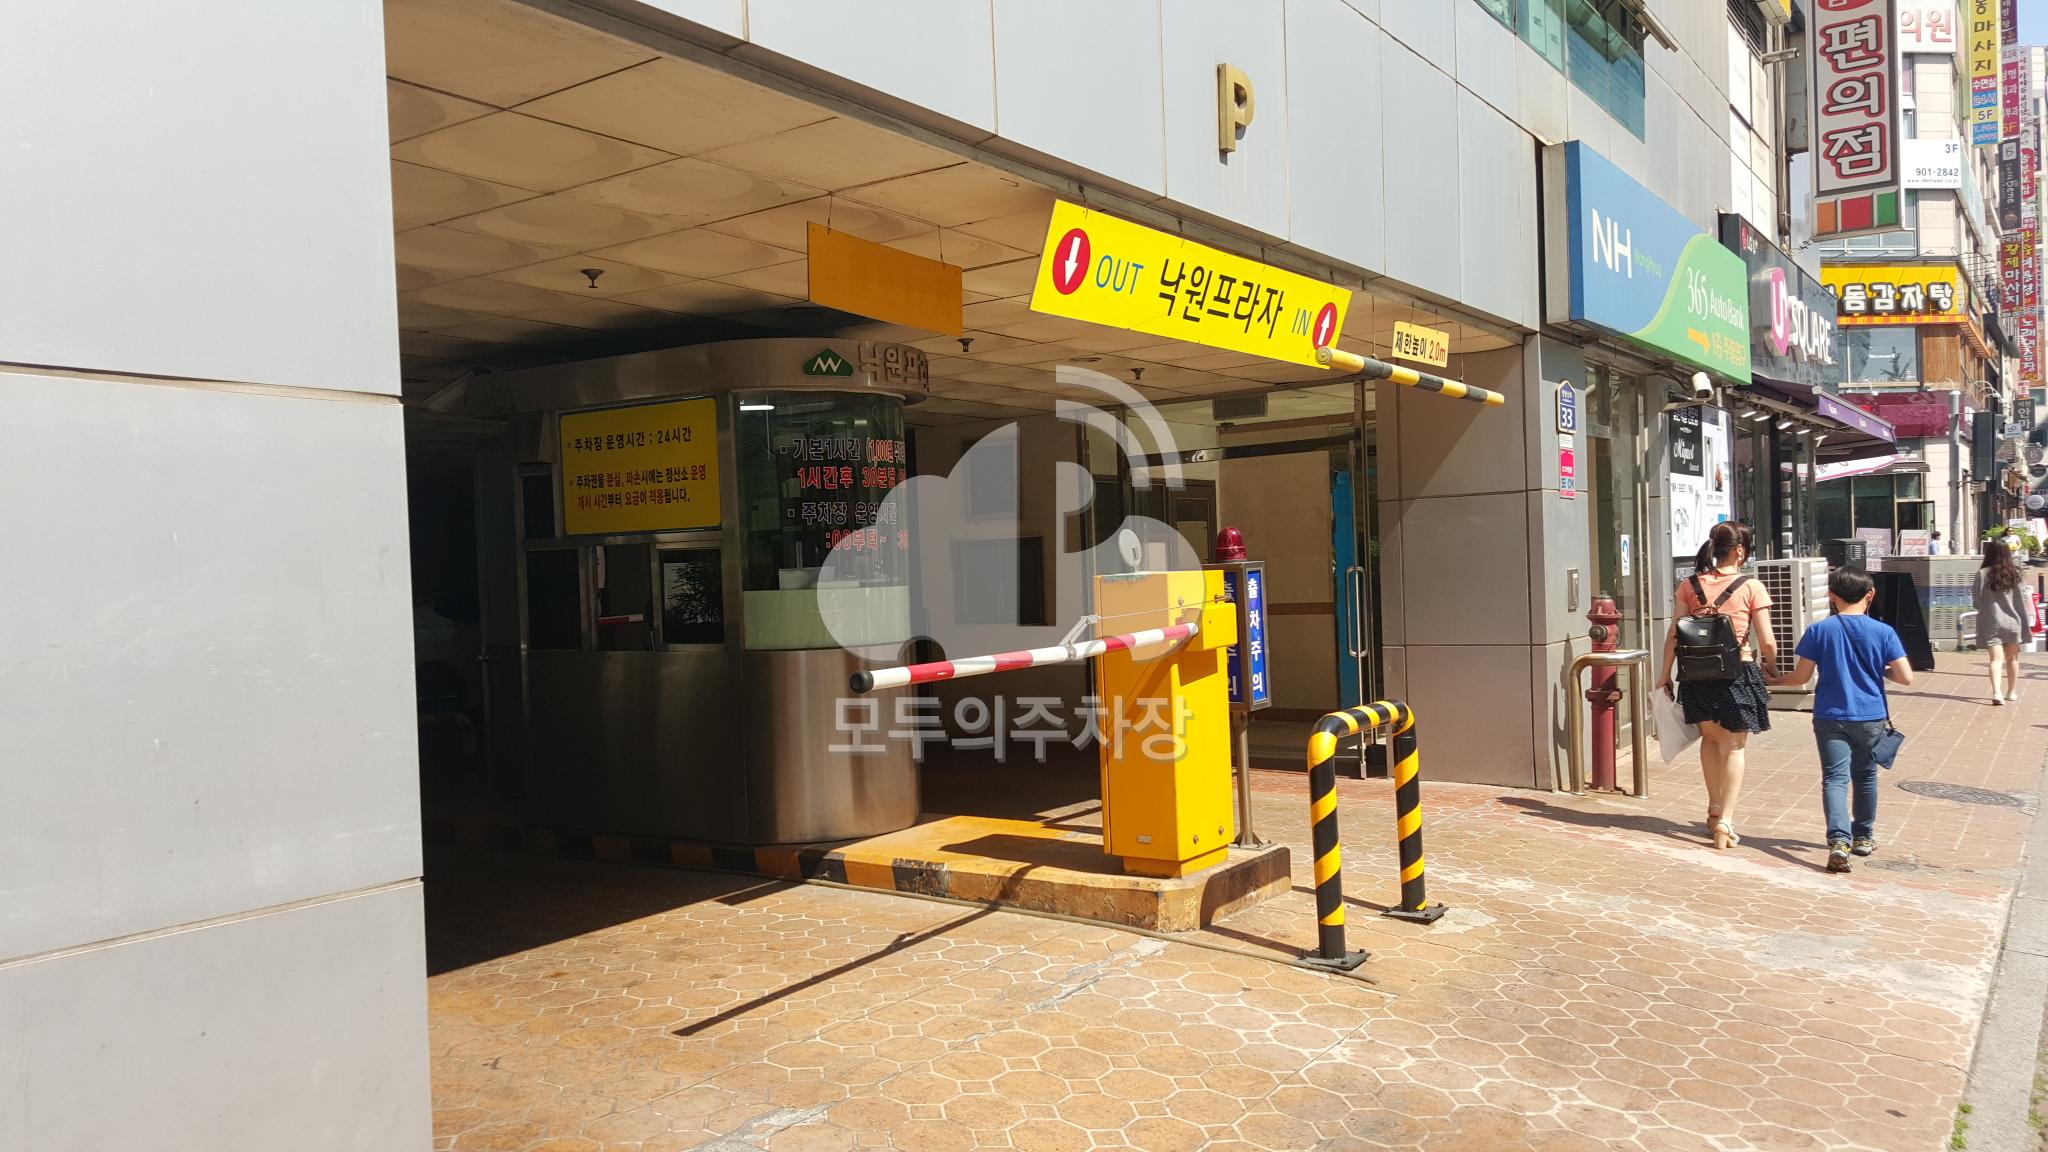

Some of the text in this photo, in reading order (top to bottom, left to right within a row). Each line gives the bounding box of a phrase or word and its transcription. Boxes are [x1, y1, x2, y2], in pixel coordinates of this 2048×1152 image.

[1217, 62, 1254, 152] P
[1823, 18, 1883, 175] 편의점
[1978, 109, 1993, 120] 5F
[1944, 143, 1958, 153] 3F
[1915, 167, 1959, 177] 901-2842
[1592, 208, 1632, 279] NH
[1095, 254, 1144, 295] OUT
[1158, 258, 1285, 339] 낙원프라자
[1687, 267, 1708, 320] 365
[1291, 307, 1312, 337] IN
[1788, 295, 1832, 365] SQUARE
[1395, 331, 1427, 359] 제한높이
[1561, 407, 1573, 428] 33
[575, 436, 602, 453] 주차장
[606, 431, 645, 450] 운영시간
[657, 425, 692, 445] 24시간
[792, 438, 861, 462] 기본1시간
[625, 468, 663, 486] 파손시에는
[665, 466, 689, 483] 정산소
[690, 463, 706, 481] 운영
[797, 466, 854, 490] 1시간후
[577, 495, 592, 511] 개시
[593, 492, 622, 510] 시간부터
[625, 490, 647, 507] 요금이
[801, 501, 897, 525] 주차장 운영시간
[1247, 578, 1263, 693] 출차주의
